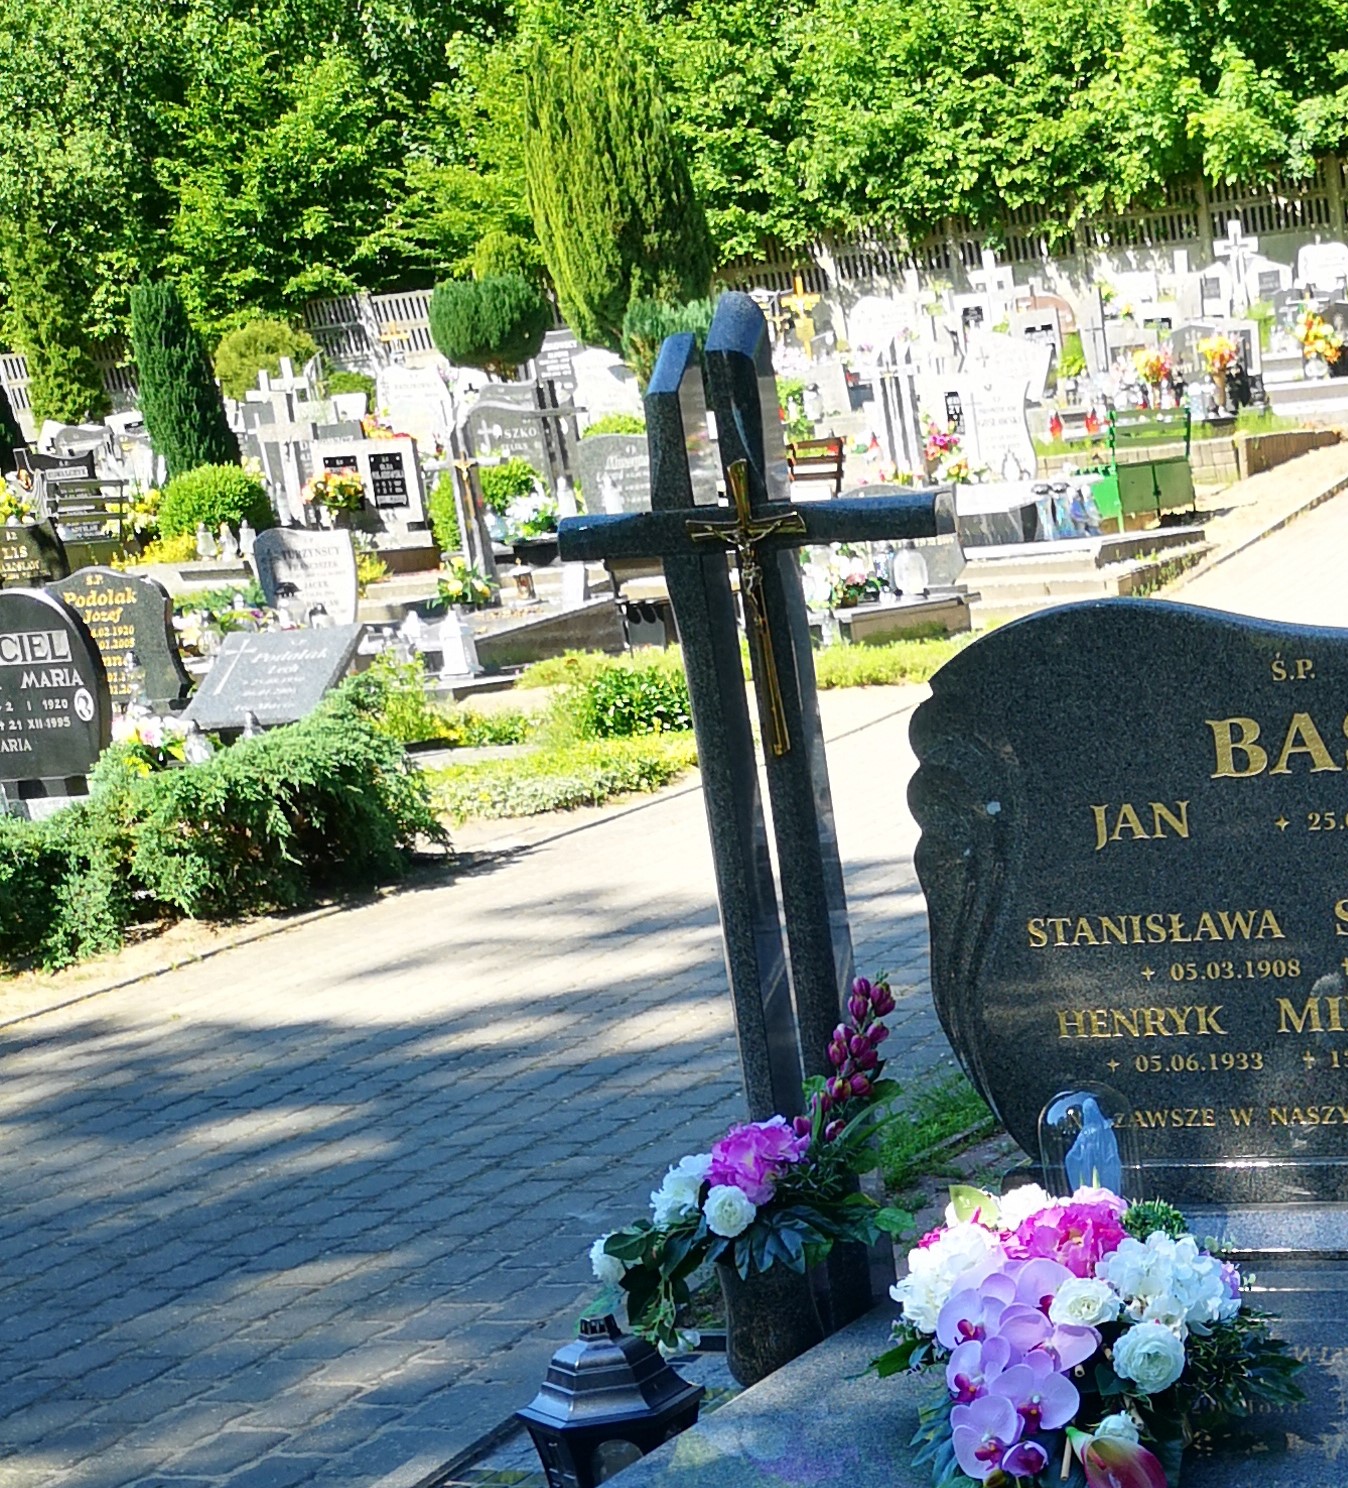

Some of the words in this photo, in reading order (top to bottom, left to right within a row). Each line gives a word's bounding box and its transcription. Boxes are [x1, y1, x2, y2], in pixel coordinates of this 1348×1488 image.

[63, 586, 138, 608] Podolak
[0, 633, 69, 662] CIEL
[1271, 652, 1317, 681] Ś.P.
[20, 668, 84, 689] MARIA
[42, 698, 68, 710] 1920
[1090, 801, 1190, 850] JAN
[1027, 909, 1286, 947] STANISŁAWA
[1169, 959, 1301, 981] 05.03.1908
[1057, 1005, 1228, 1039] HENRYK
[1135, 1052, 1264, 1072] 05.06.1933
[1113, 1108, 1216, 1128] ZAWSZE
[1230, 1108, 1254, 1128] W
